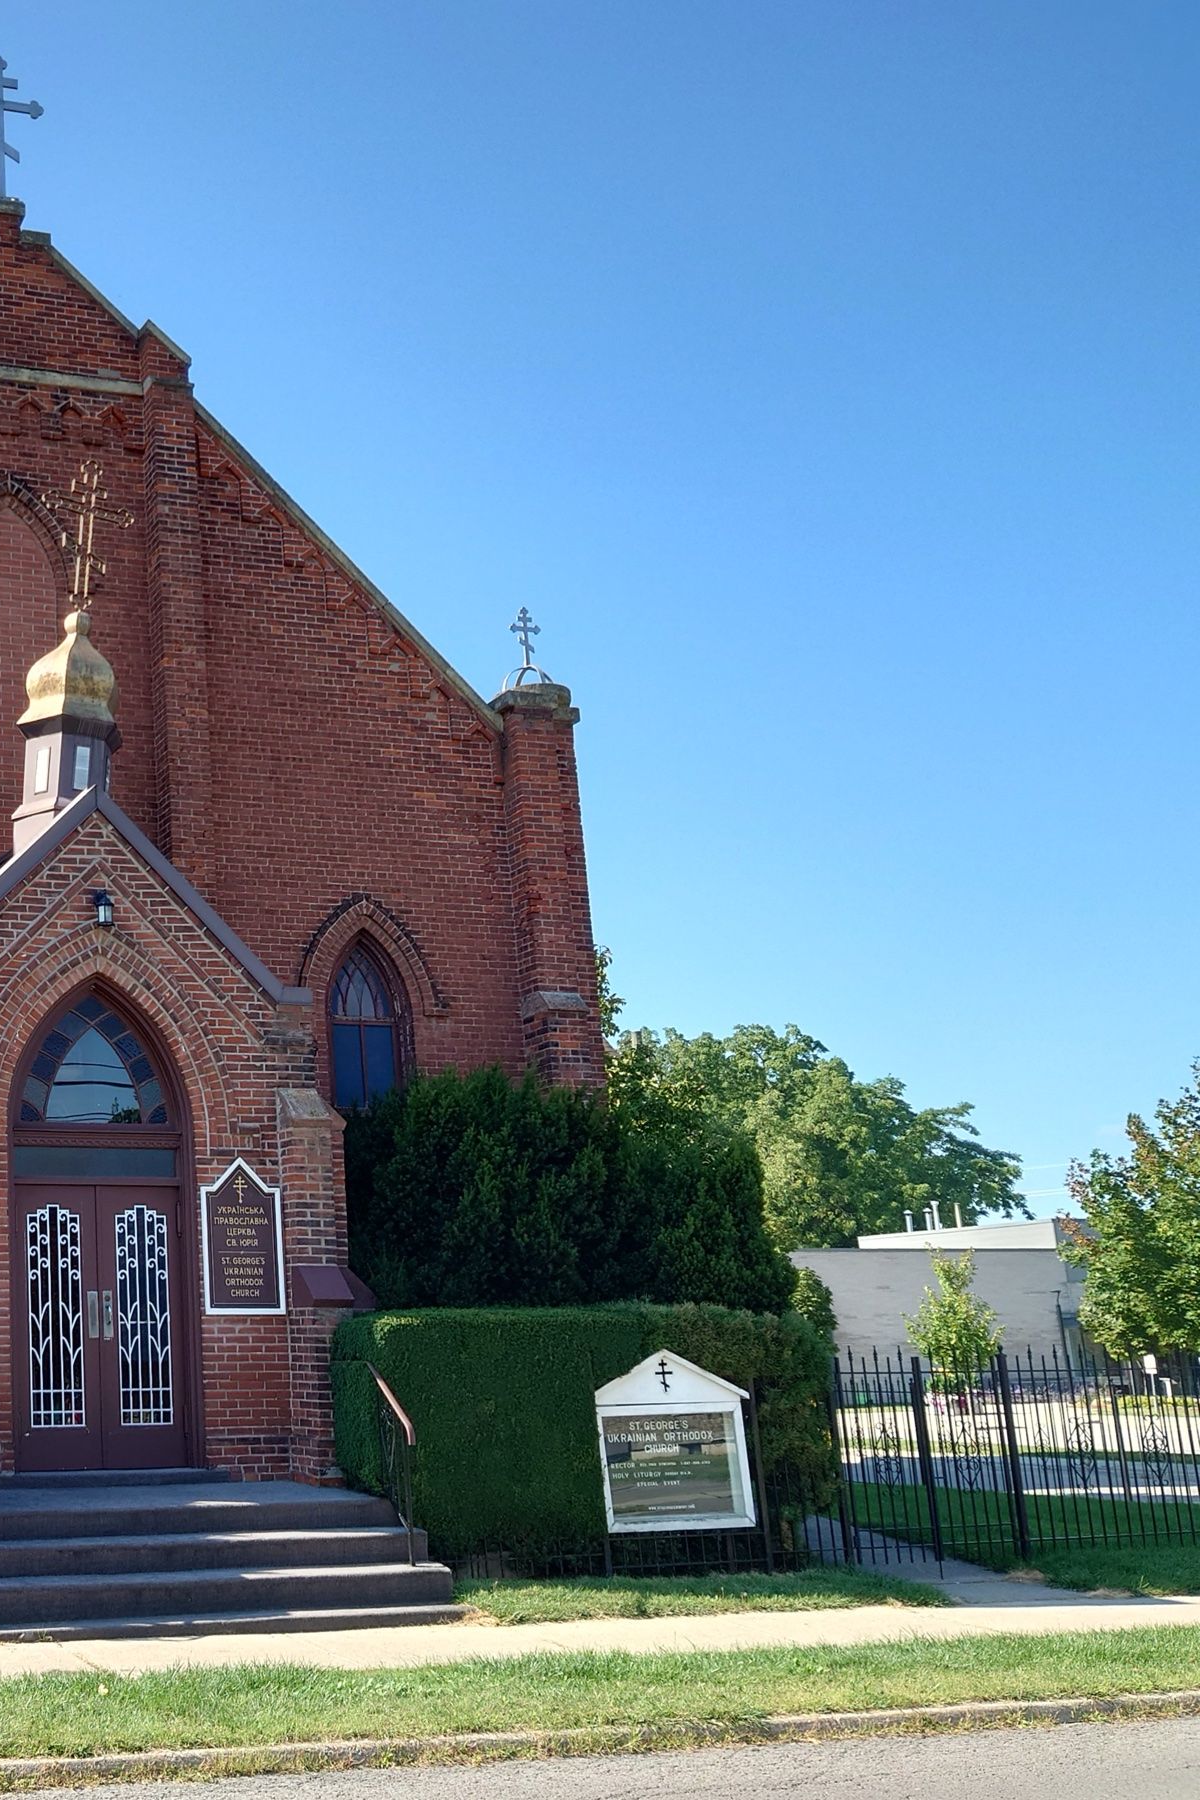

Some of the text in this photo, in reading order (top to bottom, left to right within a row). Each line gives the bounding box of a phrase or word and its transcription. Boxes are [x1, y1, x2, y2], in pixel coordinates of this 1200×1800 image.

[217, 1205, 265, 1215] УКРАЇНСЬКА
[214, 1217, 269, 1225] ПРАВОСЛАВНА
[226, 1228, 256, 1237] ЦЕРКВА
[226, 1238, 258, 1247] СВ. ЮРІЯ
[221, 1256, 265, 1265] ST. GEORGE'S
[224, 1267, 263, 1275] UKRAINIAN
[225, 1278, 264, 1286] ORTHODOX
[230, 1289, 260, 1297] CHURCH
[607, 1431, 713, 1443] UKRAINIAN ORTHODOX
[644, 1443, 680, 1453] CHURCH
